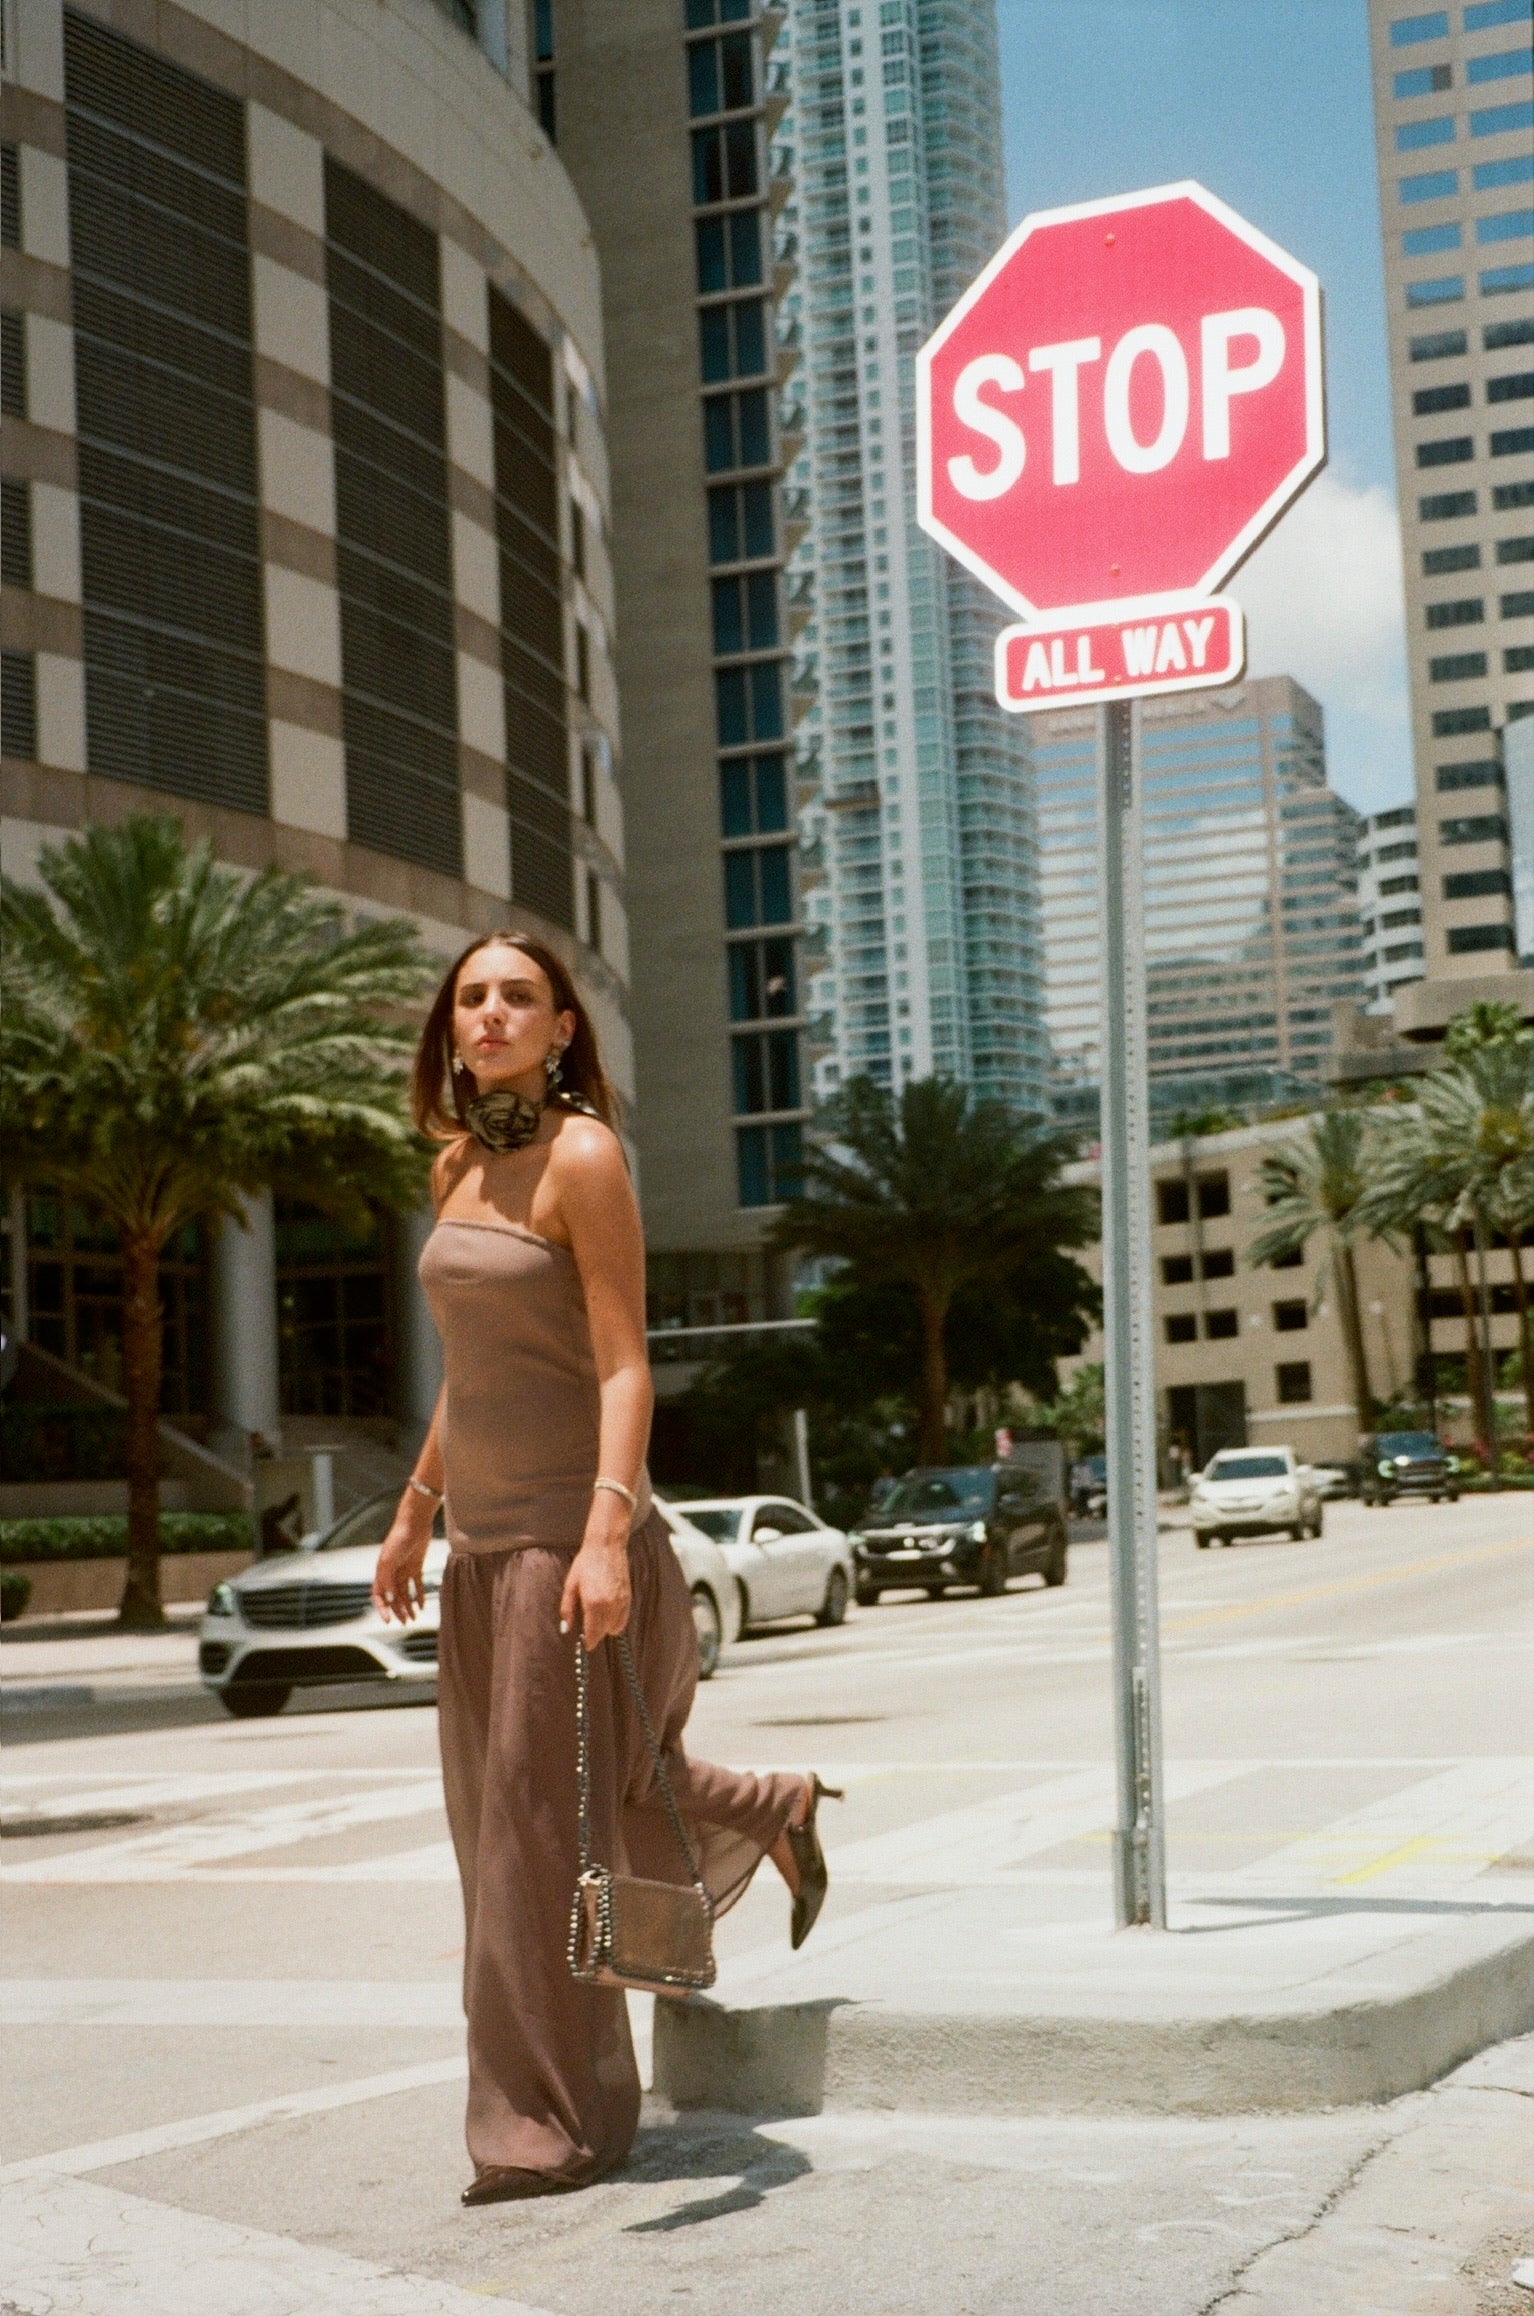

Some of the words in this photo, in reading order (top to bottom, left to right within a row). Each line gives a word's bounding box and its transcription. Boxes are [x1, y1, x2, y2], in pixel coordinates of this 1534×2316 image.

[947, 307, 1286, 500] STOP
[1022, 635, 1105, 692] ALL
[1121, 616, 1215, 677] WAY
